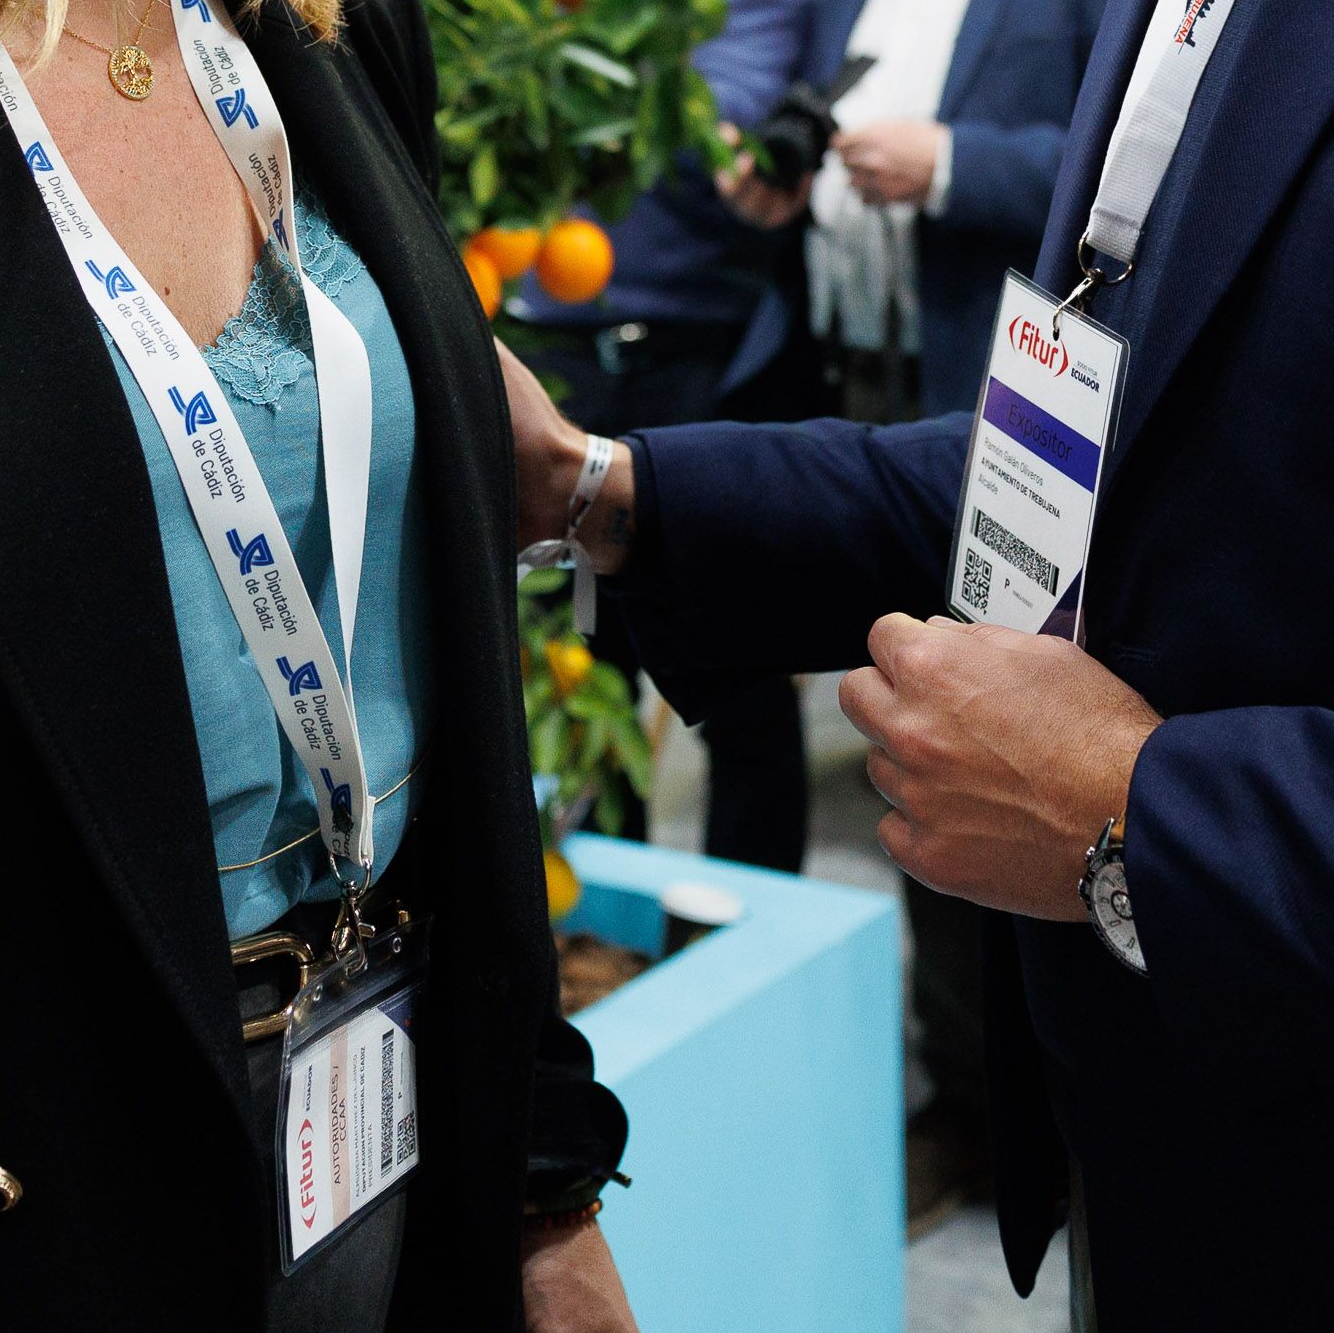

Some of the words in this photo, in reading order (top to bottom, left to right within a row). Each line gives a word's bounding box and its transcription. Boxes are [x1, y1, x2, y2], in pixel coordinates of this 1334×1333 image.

[193, 39, 224, 95] Diputación
[214, 45, 234, 69] Cádiz
[227, 71, 241, 85] de
[249, 153, 276, 218] Diputación
[267, 154, 282, 189] Cádiz
[277, 189, 283, 206] de
[46, 200, 71, 234] Cádiz
[48, 176, 93, 240] Diputación
[117, 302, 134, 322] de
[130, 318, 158, 358] Cádiz
[132, 296, 180, 361] Diputación
[1070, 367, 1100, 393] ECUADOR
[1008, 404, 1072, 461] Expositor
[191, 438, 207, 459] de
[200, 457, 223, 500] Cádiz
[208, 427, 246, 504] Diputación
[981, 457, 1020, 490] AYUNTAMIENTO
[1020, 484, 1028, 496] DE
[1028, 489, 1060, 518] TREBUJENA
[244, 577, 259, 597] de
[252, 593, 274, 632] Cádiz
[263, 569, 298, 636] Diputación
[293, 699, 308, 718] de
[298, 713, 321, 751] Cádiz
[312, 693, 342, 761] Diputación
[331, 1073, 341, 1184] AUTORIDADES
[339, 1097, 347, 1141] CCAA
